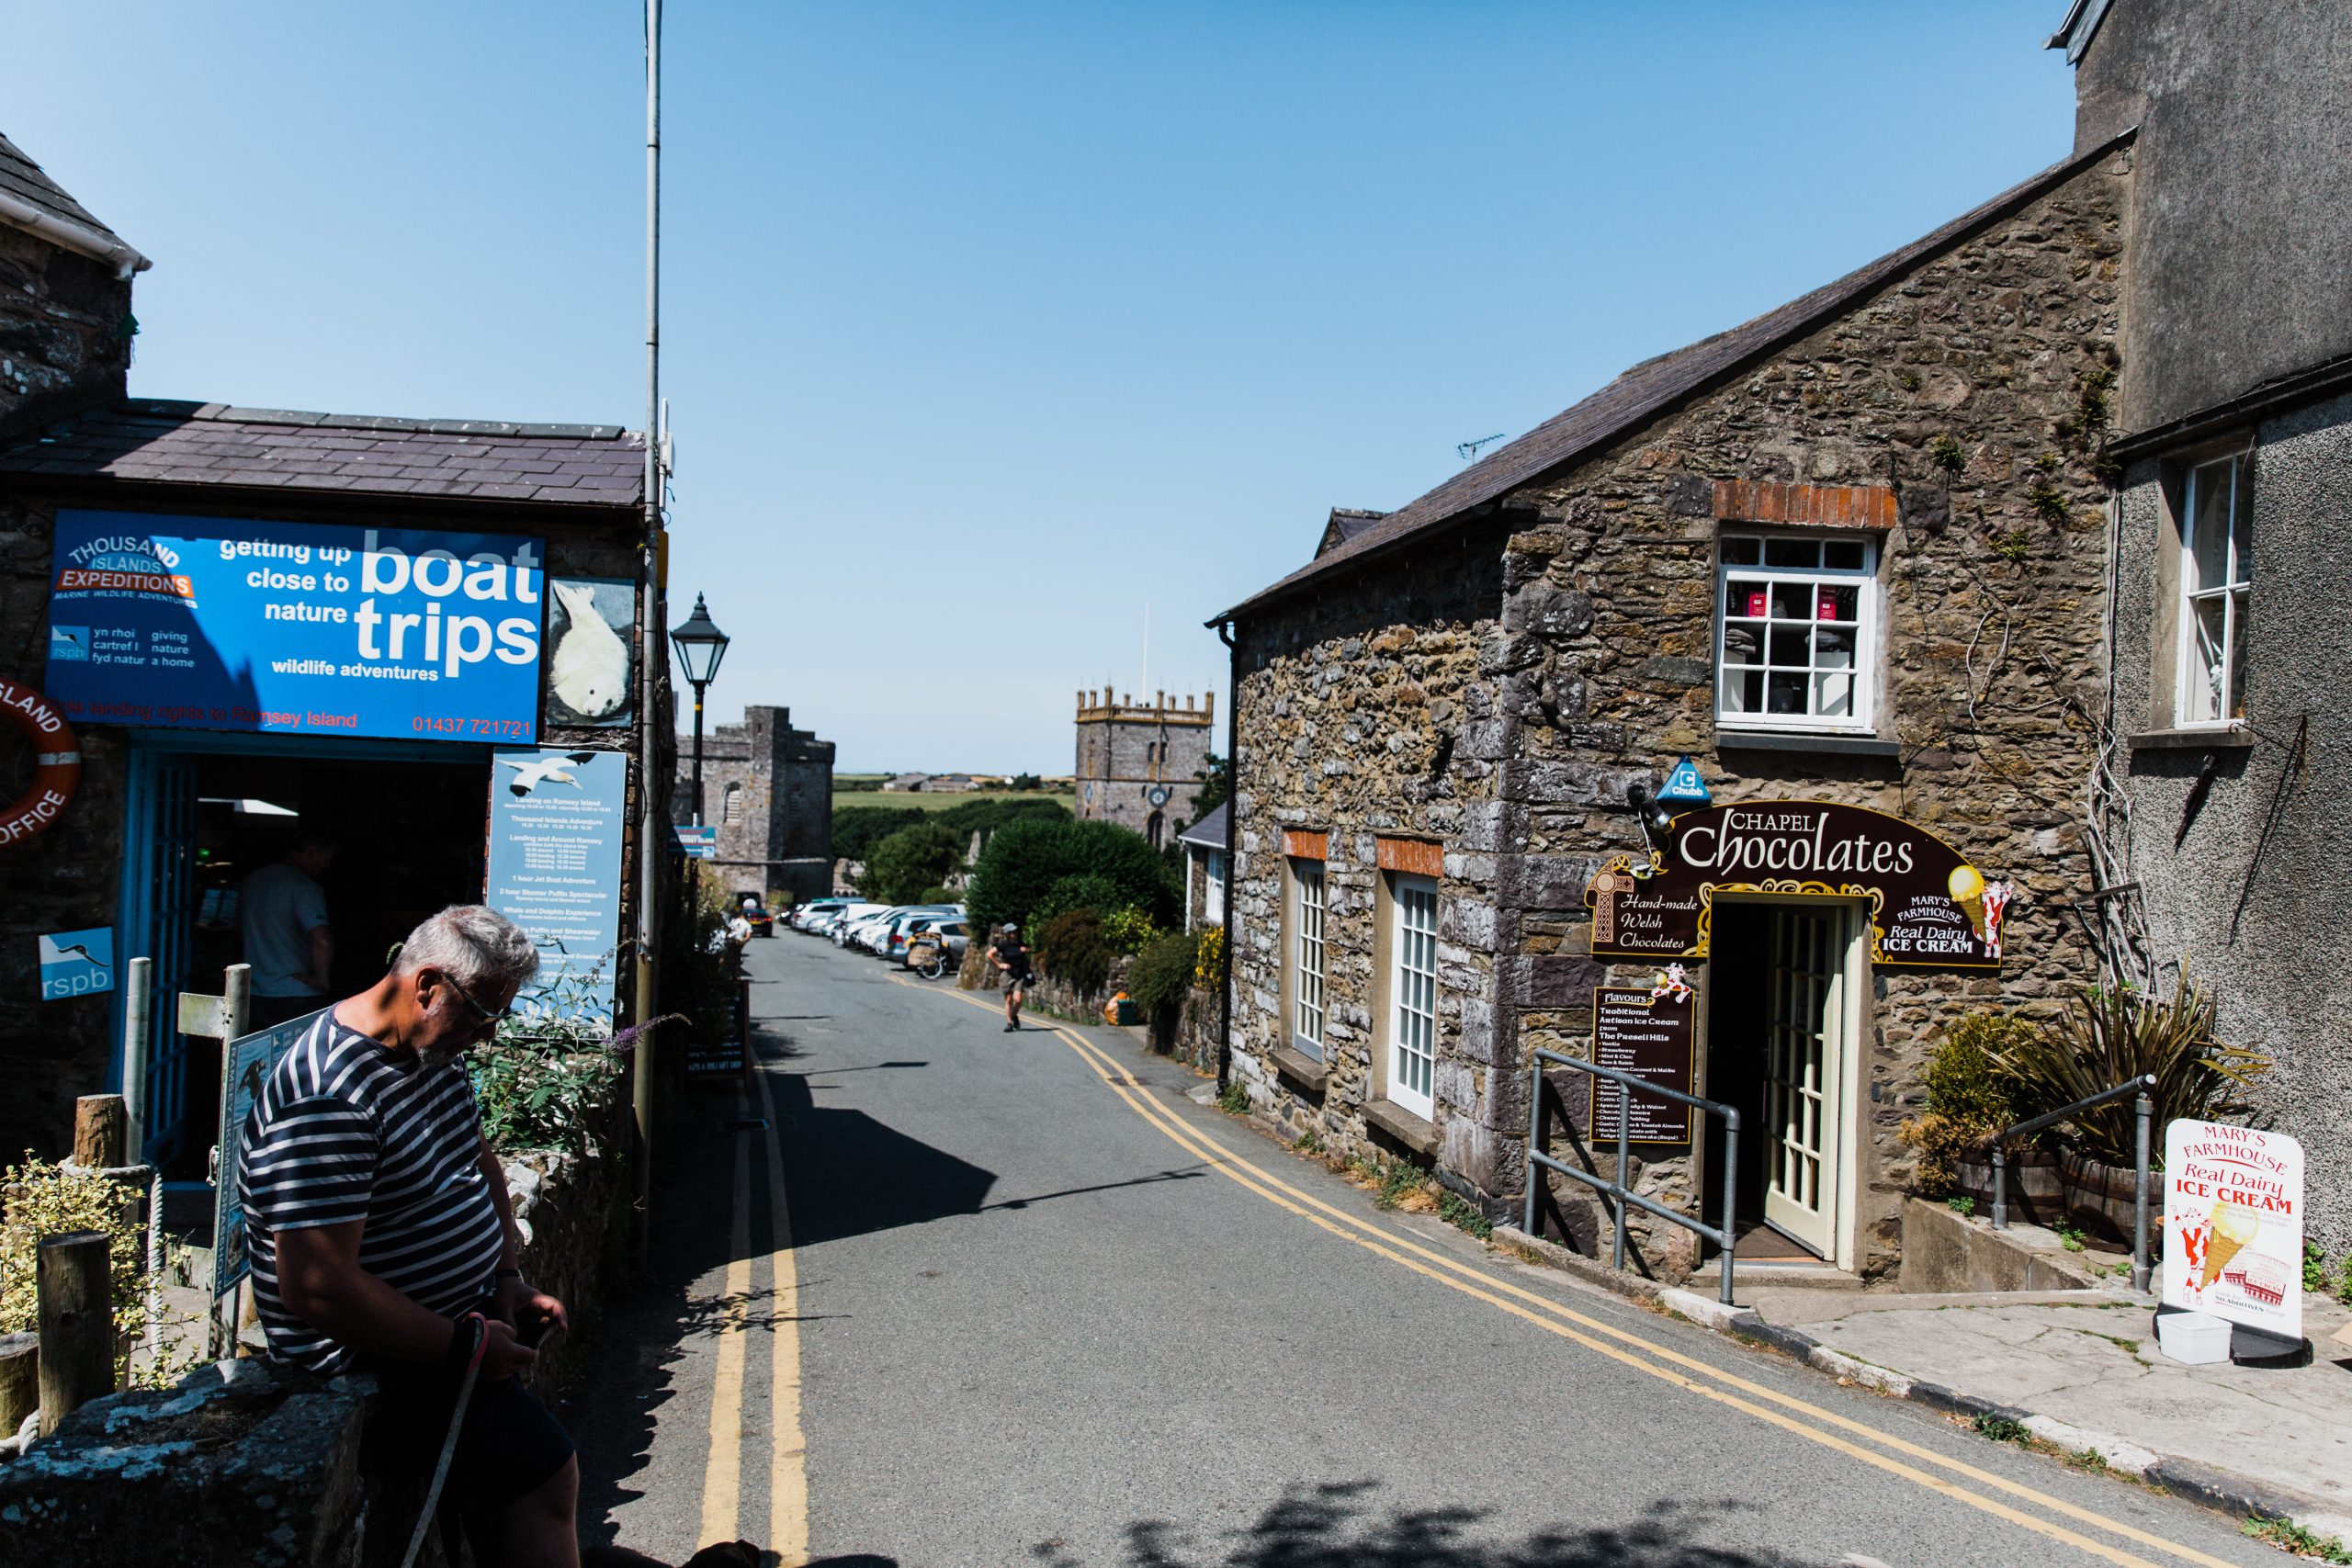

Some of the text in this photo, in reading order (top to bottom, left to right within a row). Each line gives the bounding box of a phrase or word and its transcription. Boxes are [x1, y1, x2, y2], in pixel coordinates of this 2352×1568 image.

[68, 536, 180, 568] THOUSAND
[219, 536, 351, 566] getting up
[92, 557, 162, 573] ISLANDS
[361, 529, 538, 604] boat
[62, 570, 189, 594] EXPEDITIONS
[246, 568, 350, 592] close to
[53, 590, 198, 609] MARINE WILDLIFE ADVENTURES
[265, 603, 347, 624] nature
[94, 628, 135, 638] yn rhoi
[152, 631, 187, 643] giving
[354, 597, 538, 678] trips
[93, 641, 132, 650] cartref
[152, 644, 189, 654] nature
[92, 652, 145, 664] fyd natur
[162, 657, 195, 667] home
[271, 659, 438, 681] wildlife adventures
[89, 701, 152, 719] landing
[157, 704, 205, 722] rights
[209, 705, 226, 721] to
[232, 706, 301, 728] Ramsey
[307, 711, 357, 728] Island
[413, 716, 531, 735] 01437 721721
[1671, 785, 1703, 797] Chubb
[515, 796, 542, 805] Landing
[553, 798, 579, 807] Ramsey
[1730, 813, 1815, 831] CHAPEL
[510, 834, 537, 842] Landing
[1679, 808, 1913, 876] Chocolates
[1620, 893, 1698, 910] Hand-made
[1911, 896, 1950, 907] MARY'S
[1621, 912, 1662, 929] Welsh
[1896, 907, 1962, 924] FARMHOUSE
[564, 928, 601, 936] Shearwater
[1620, 932, 1685, 948] Chocolates
[1890, 925, 1966, 943] Real Dairy
[1883, 938, 1973, 953] ICE CREAM
[42, 967, 108, 998] rspb
[1604, 993, 1646, 1003] Flavours
[1600, 1007, 1650, 1016] Traditional
[1600, 1016, 1634, 1024] Artisan
[1648, 1018, 1679, 1026] Cream
[1617, 1032, 1648, 1041] Preseli
[227, 1047, 236, 1112] RAMSEY
[2204, 1126, 2266, 1147] MARY'S
[223, 1118, 232, 1187] SKOMER
[2183, 1143, 2288, 1176] FARMHOUSE
[2185, 1163, 2283, 1201] Real Dairy
[2177, 1179, 2291, 1214] ICE CREAM
[216, 1190, 229, 1294] GRASSHOLM
[2227, 1299, 2264, 1312] ADDITIVES
